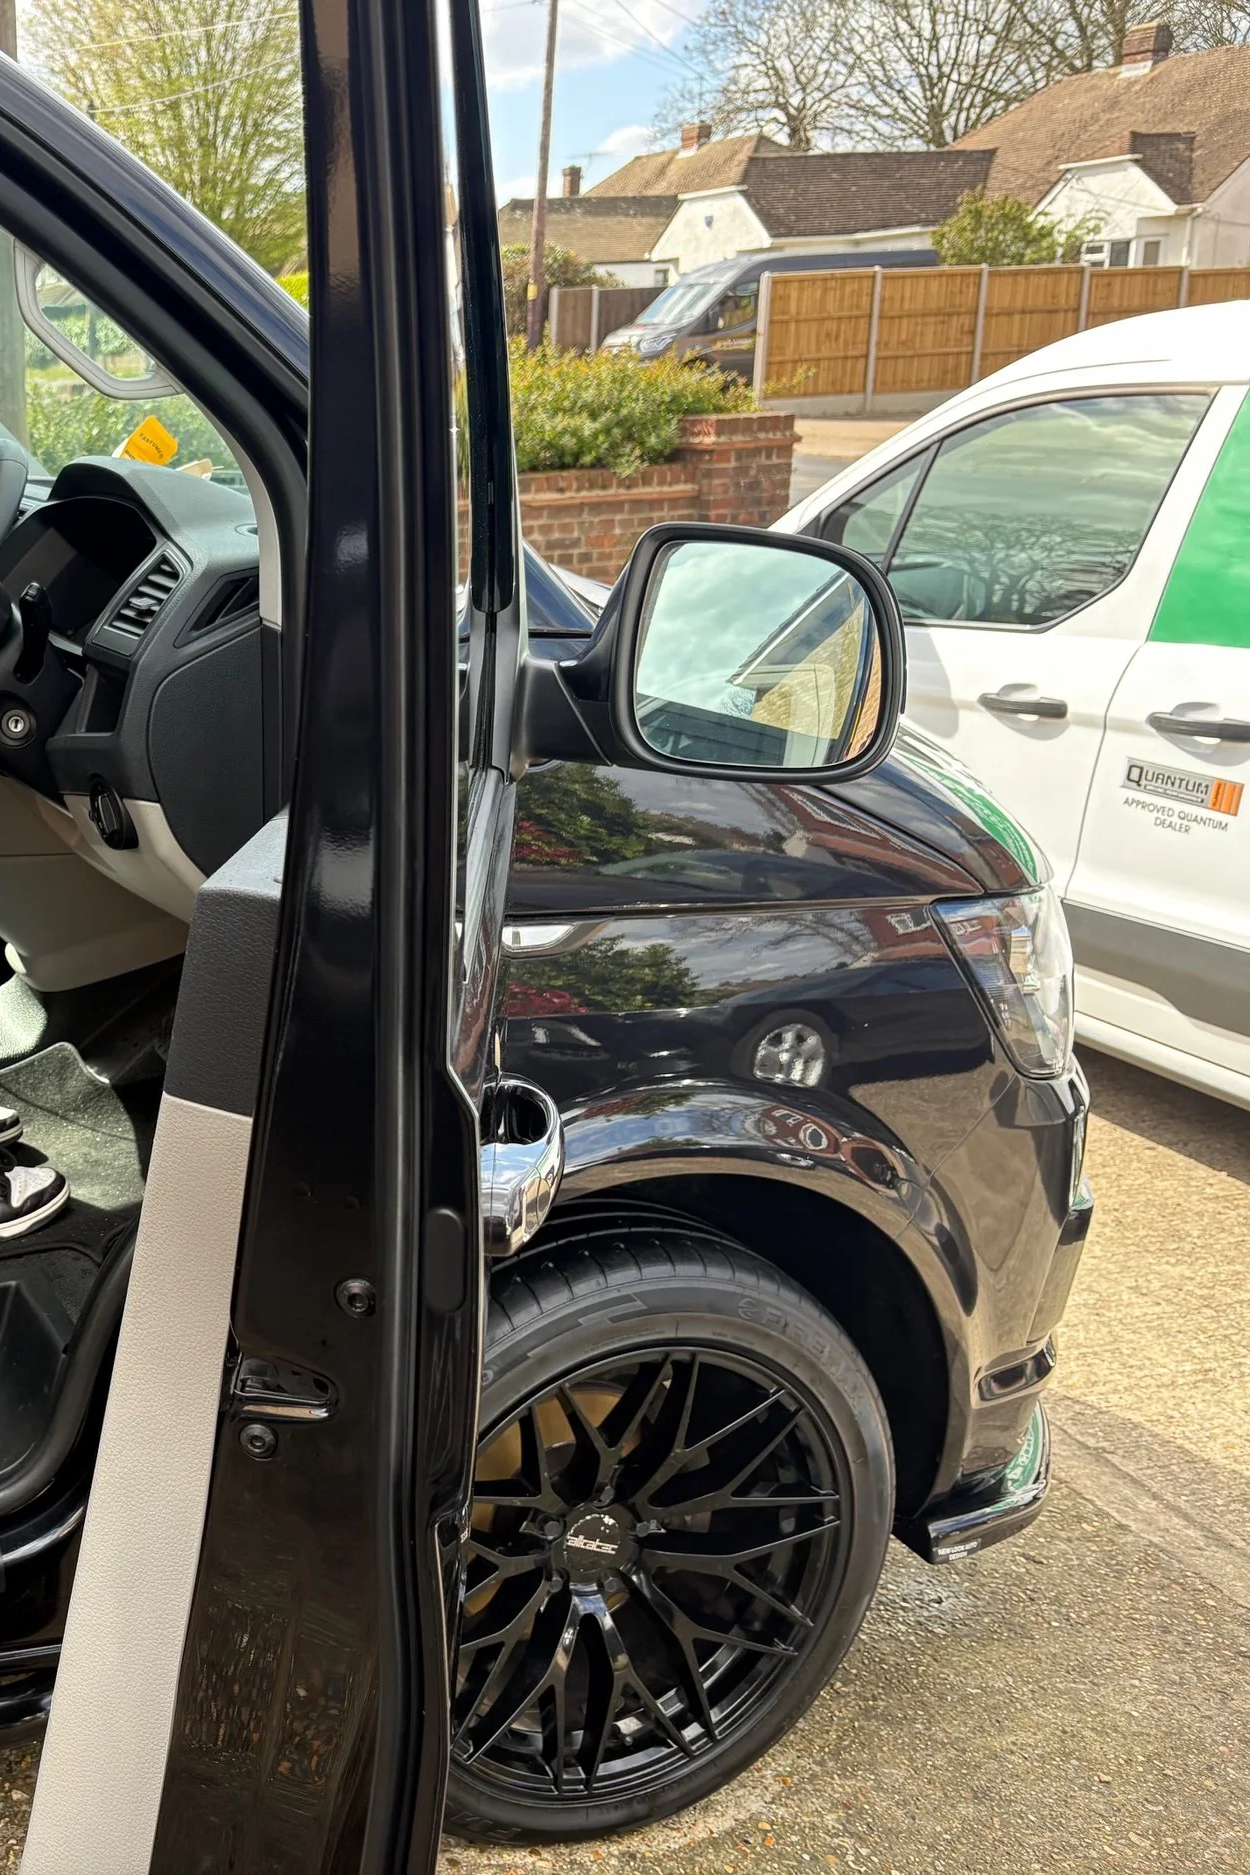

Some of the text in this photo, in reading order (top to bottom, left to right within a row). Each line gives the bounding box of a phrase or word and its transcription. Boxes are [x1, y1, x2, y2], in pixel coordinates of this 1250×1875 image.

[1127, 765, 1210, 796] QUANTUM
[1123, 797, 1229, 832] APPROVED QUANTUM
[1154, 817, 1191, 834] DEALER
[937, 1548, 951, 1556] NEW
[951, 1545, 965, 1553] LOOK
